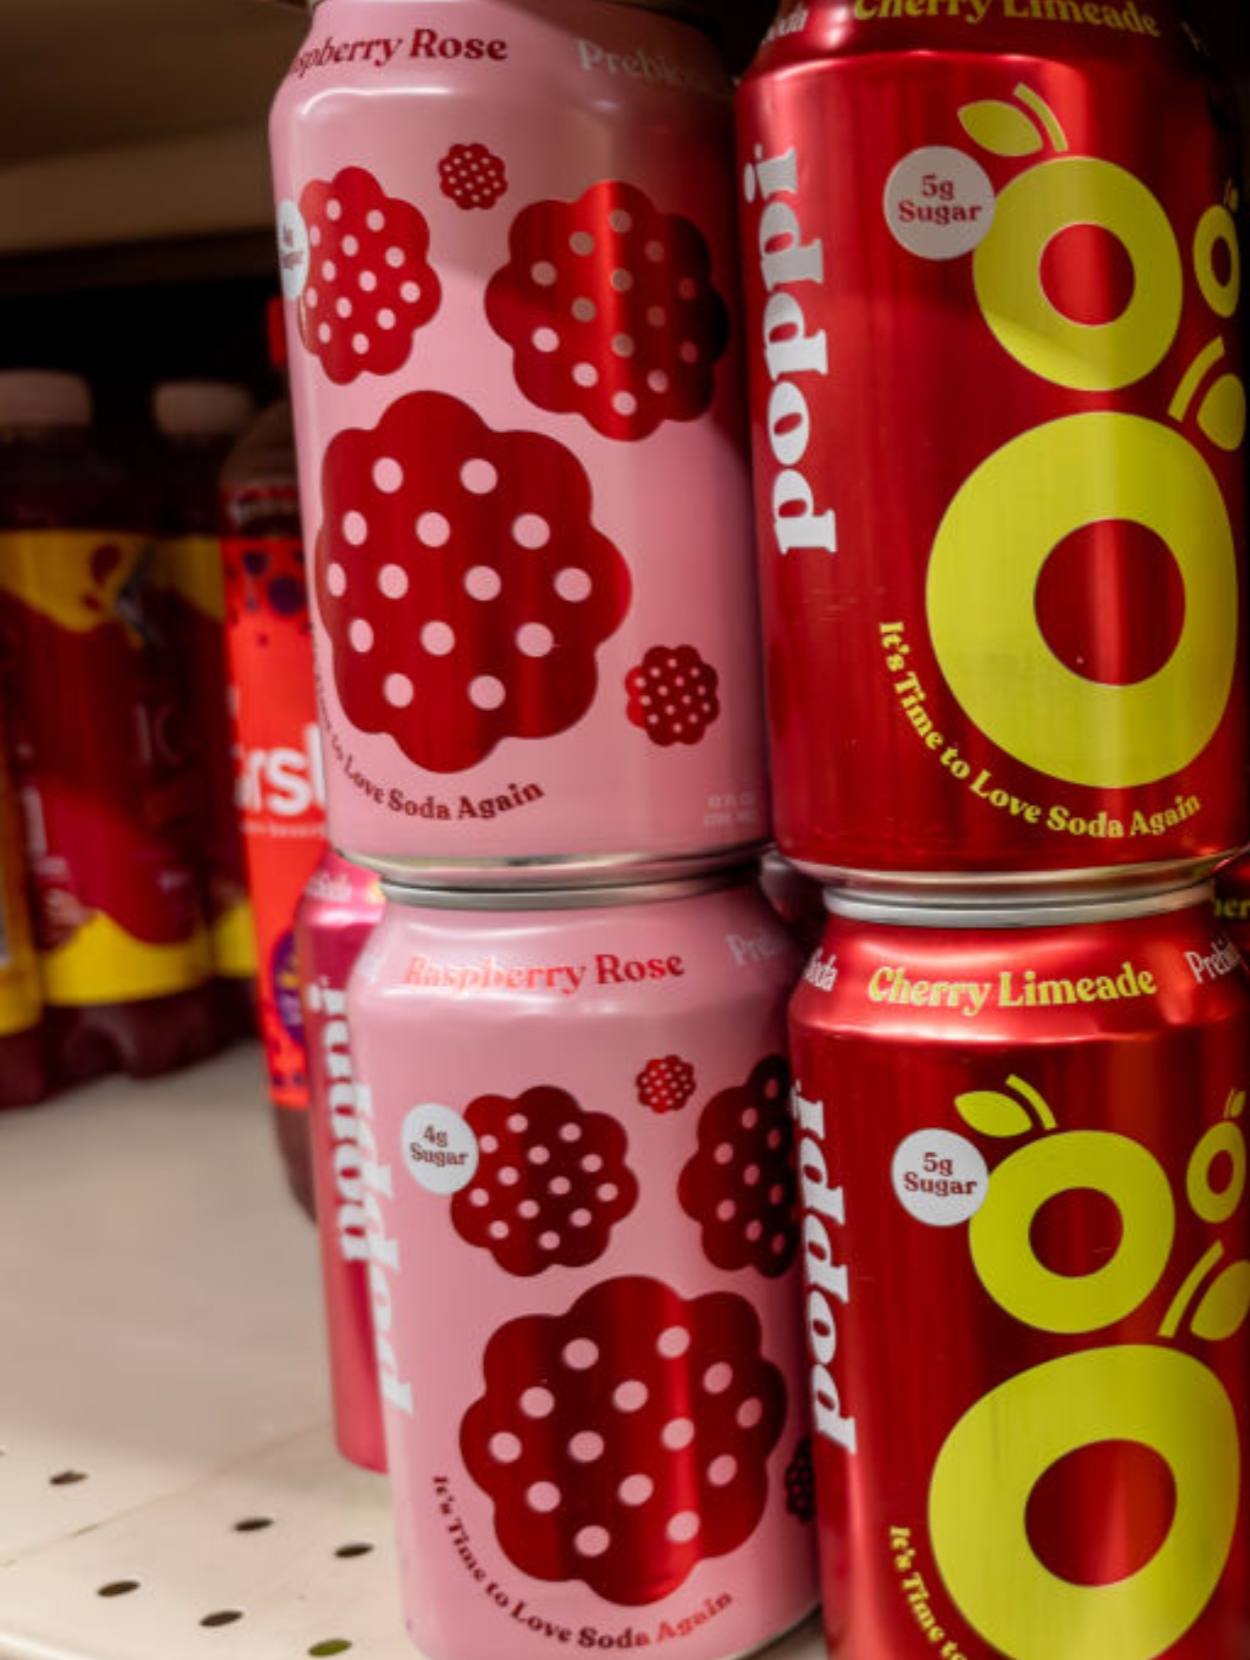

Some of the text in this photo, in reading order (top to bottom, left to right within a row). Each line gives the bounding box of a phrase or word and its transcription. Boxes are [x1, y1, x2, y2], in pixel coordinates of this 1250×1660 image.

[291, 28, 508, 78] pberry Rose
[922, 173, 955, 201] 5g
[898, 200, 982, 226] Sugar
[744, 146, 837, 554] poppi
[879, 621, 1202, 839] It's Time to Love Soda Again
[344, 755, 385, 804] Love
[388, 788, 453, 821] Soda
[457, 782, 545, 821] Again
[402, 952, 685, 996] Raspberry Rose
[867, 961, 1157, 1016] Cherry Limeade
[409, 1142, 469, 1170] Sugar
[422, 1124, 448, 1148] 4g
[903, 1171, 977, 1197] Sugar
[922, 1152, 953, 1177] 5g
[790, 1083, 858, 1454] poppi
[433, 1474, 735, 1650] It's Time to Love Soda Again
[890, 1525, 917, 1571] It's
[903, 1571, 945, 1641] Time
